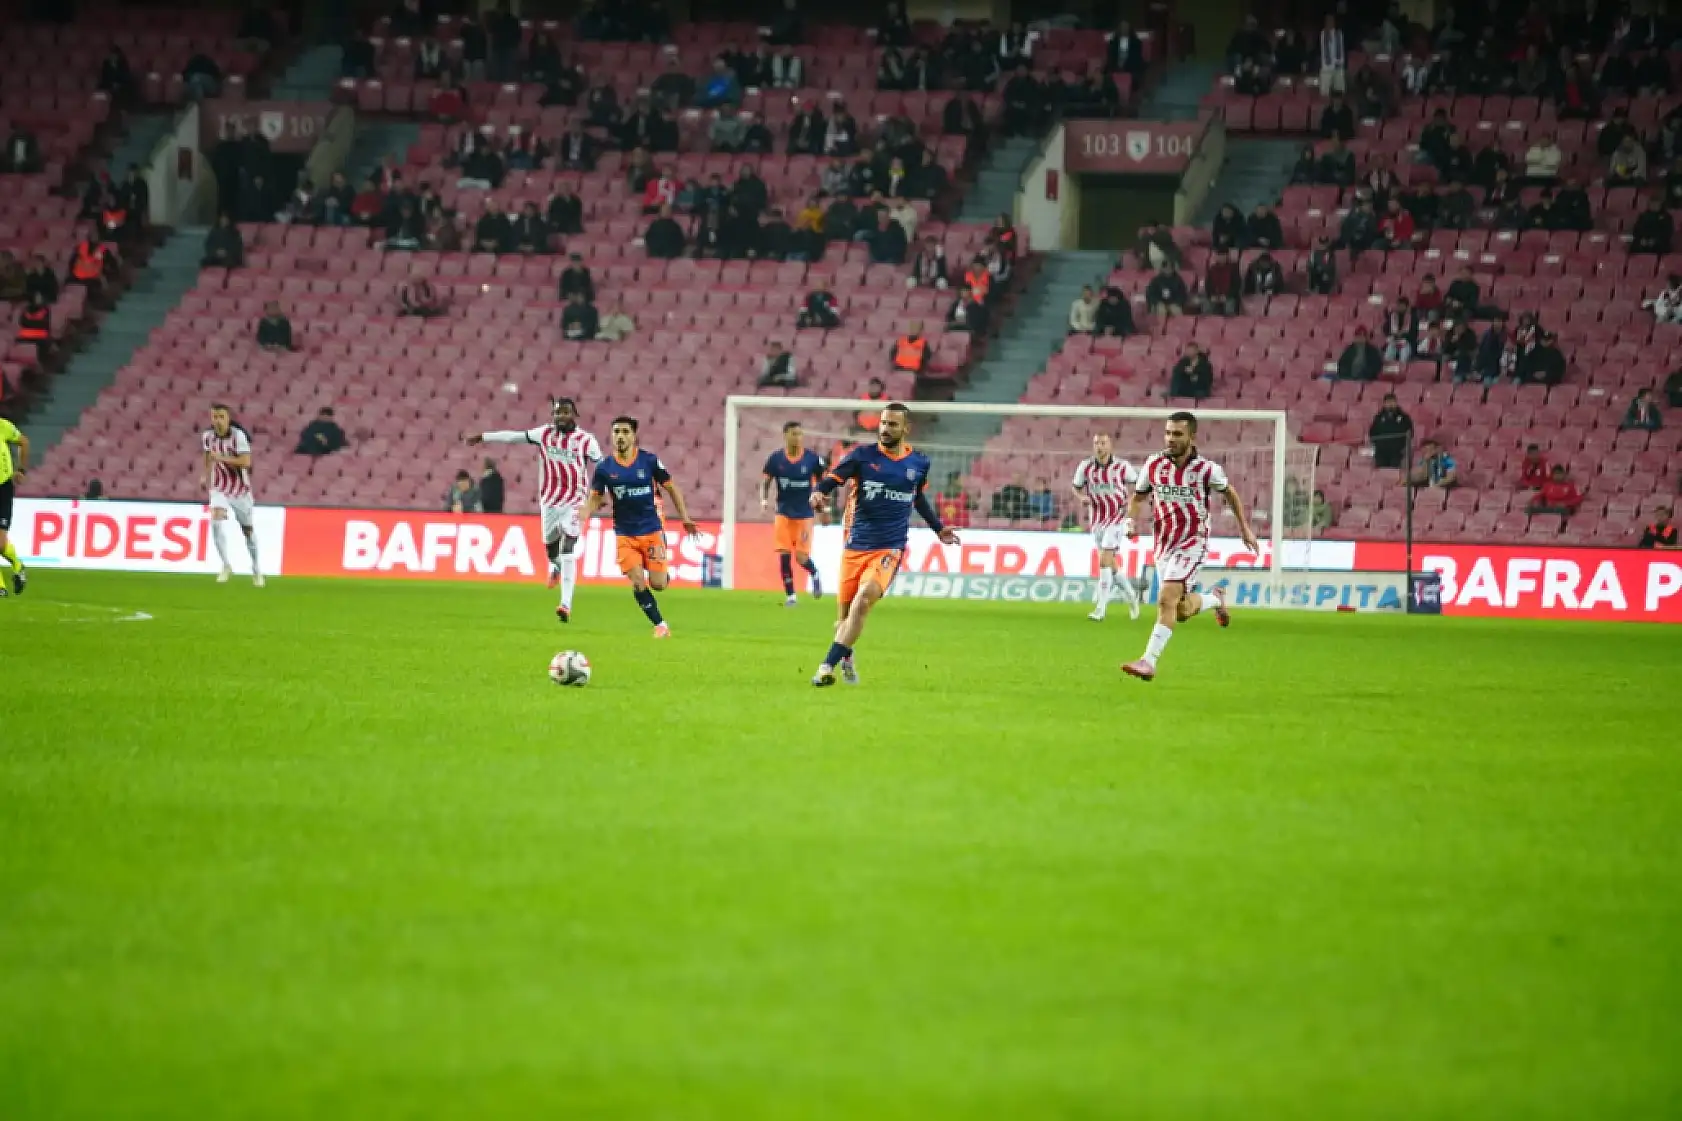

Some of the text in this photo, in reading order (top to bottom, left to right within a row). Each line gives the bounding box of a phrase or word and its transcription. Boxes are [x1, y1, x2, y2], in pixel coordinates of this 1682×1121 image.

[1083, 133, 1192, 158] 103 104
[31, 500, 211, 562] PİDESİ
[342, 520, 535, 576] BAFRA
[1422, 555, 1628, 611] BAFRA
